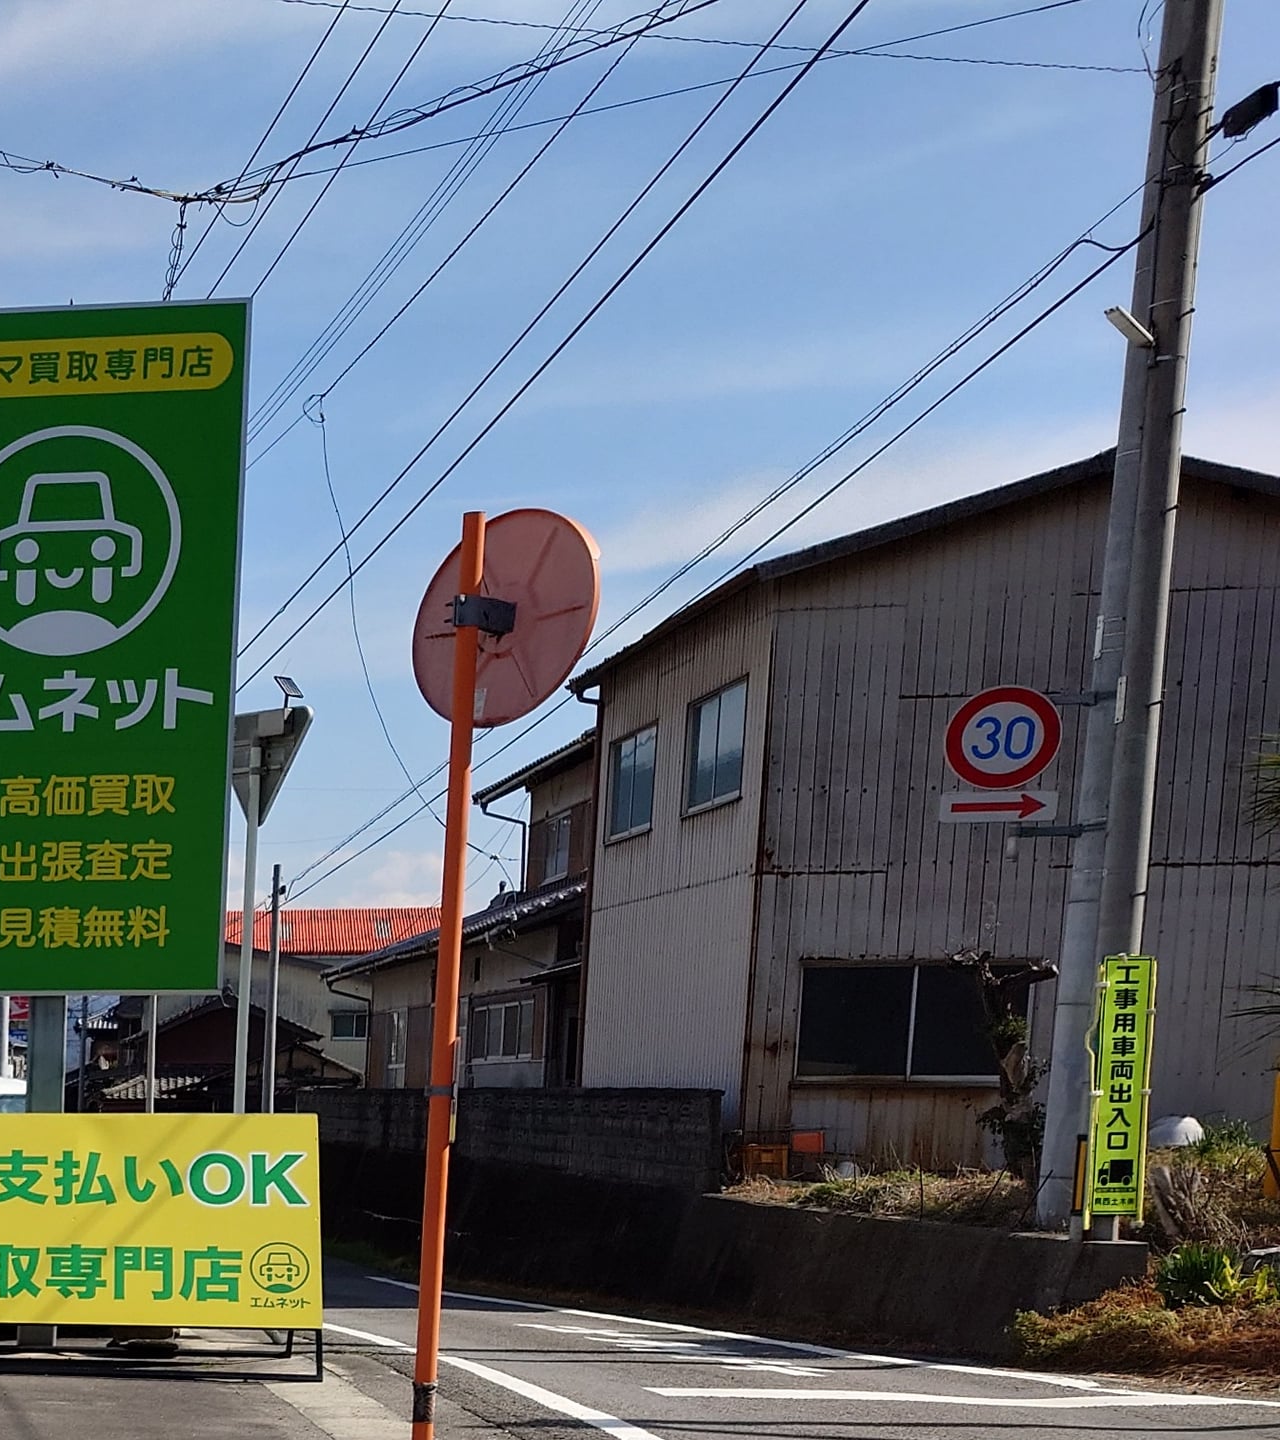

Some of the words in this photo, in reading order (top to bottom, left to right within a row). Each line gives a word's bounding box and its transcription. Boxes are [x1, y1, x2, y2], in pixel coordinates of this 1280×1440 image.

[970, 714, 1037, 761] 30
[1105, 965, 1142, 1152] 工事用車両出入口
[249, 1296, 312, 1309] エムネット
